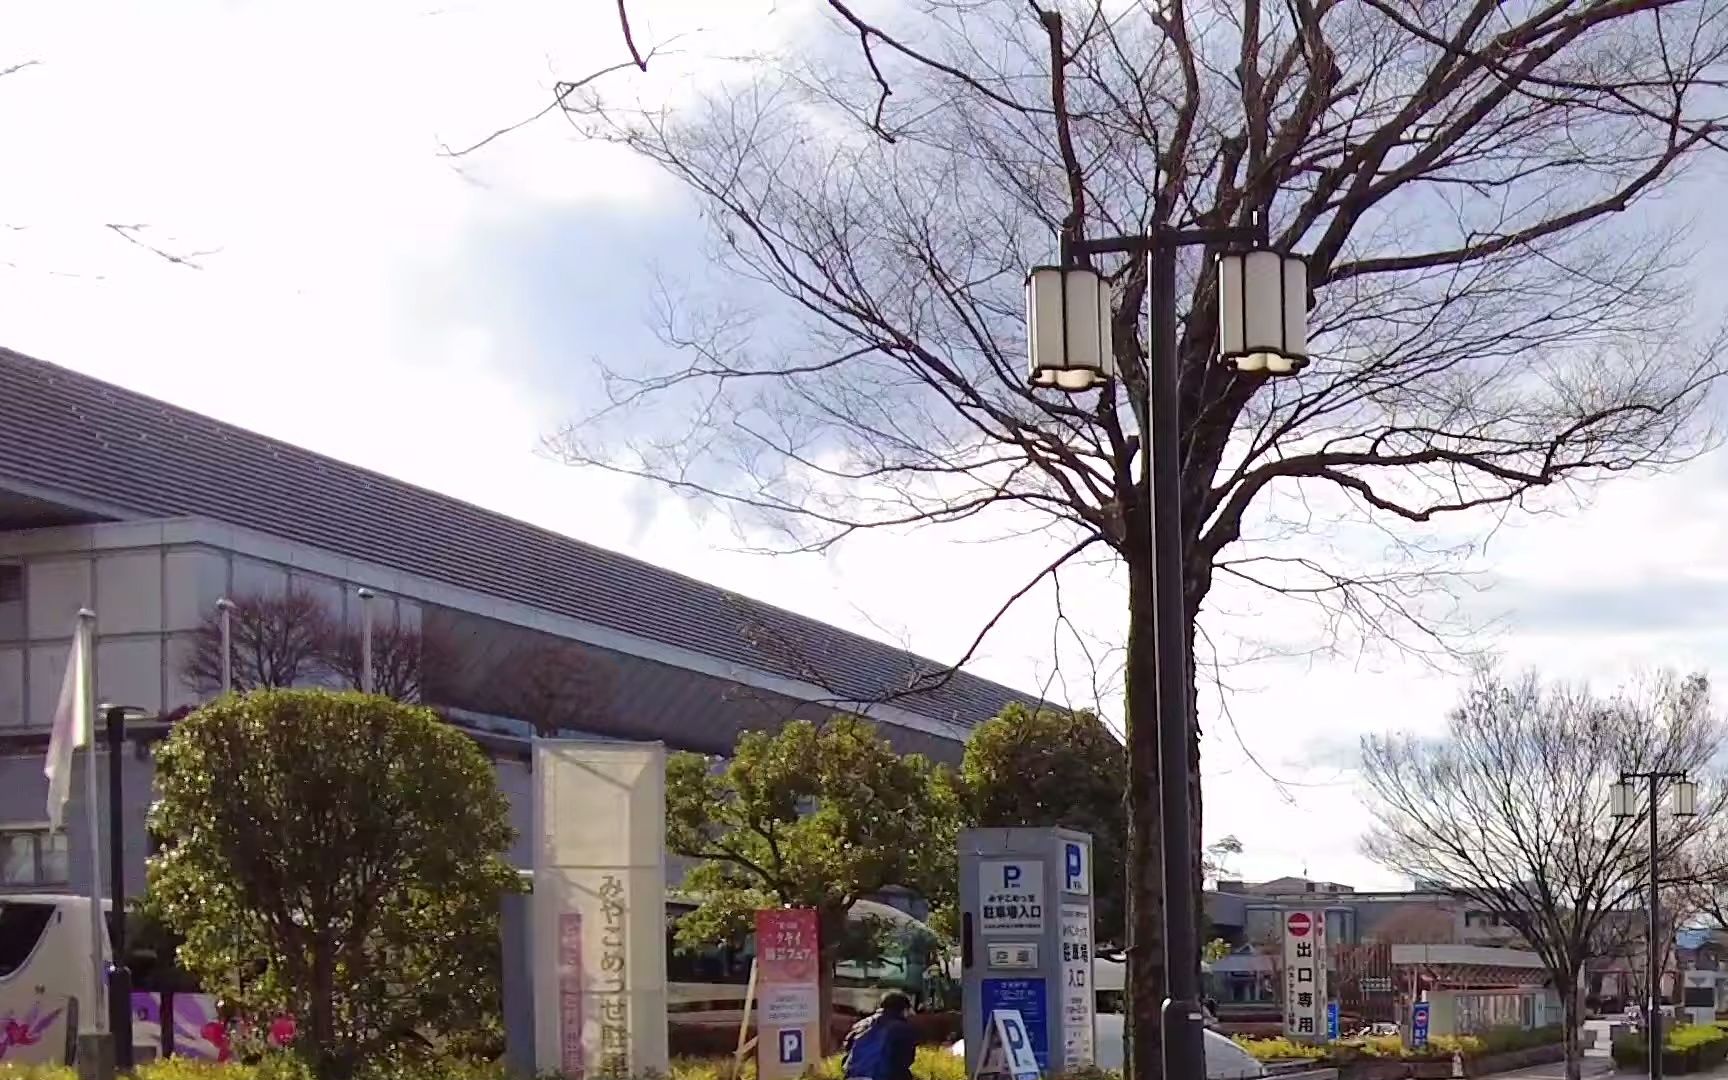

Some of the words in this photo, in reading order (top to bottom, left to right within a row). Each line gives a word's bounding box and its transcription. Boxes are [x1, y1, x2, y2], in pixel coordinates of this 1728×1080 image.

[1004, 865, 1021, 888] P
[1066, 843, 1081, 889] P
[983, 905, 1041, 919] 駐車場入口
[1063, 942, 1089, 962] 駐車場
[1068, 969, 1085, 987] 入口
[1297, 941, 1313, 1033] 出口専用
[783, 1034, 799, 1060] P
[1003, 1018, 1024, 1067] P
